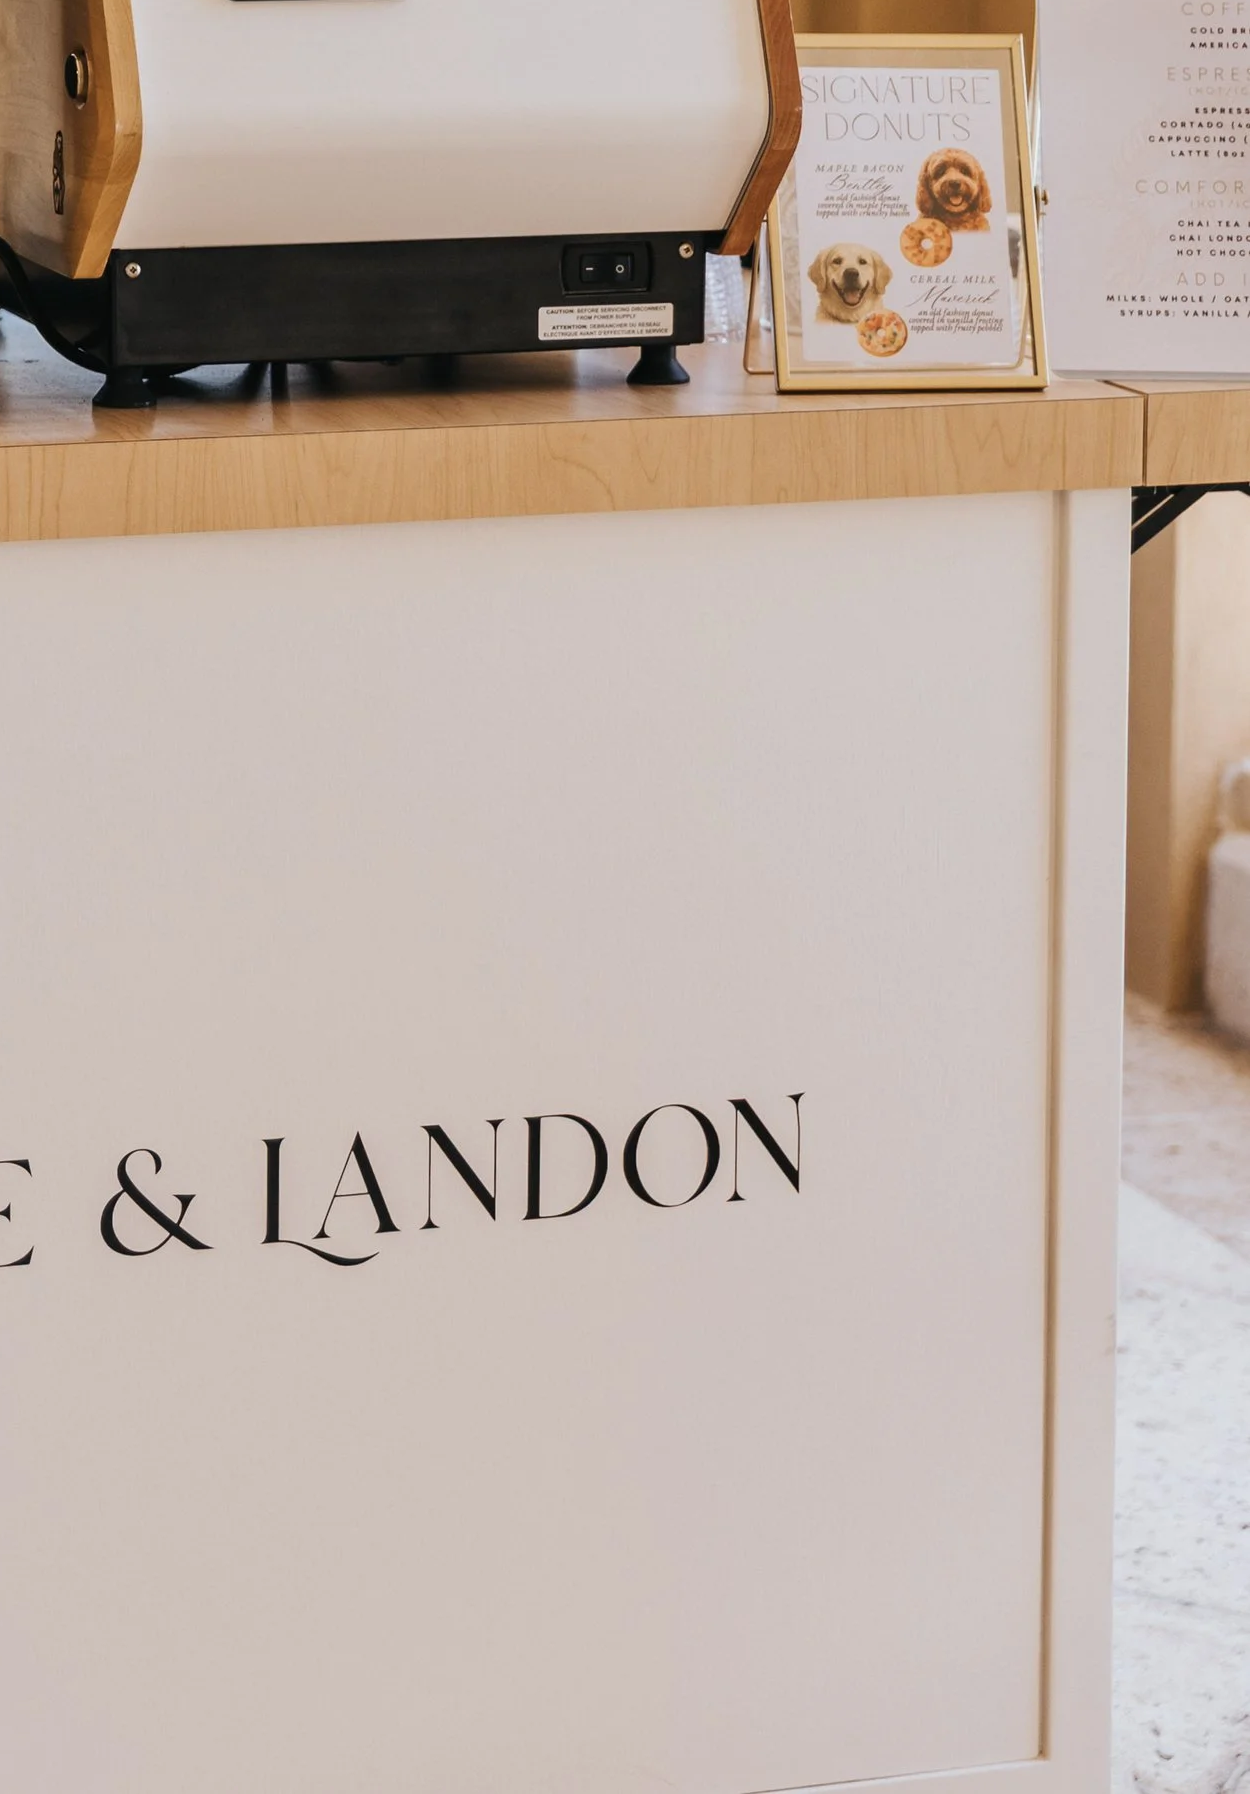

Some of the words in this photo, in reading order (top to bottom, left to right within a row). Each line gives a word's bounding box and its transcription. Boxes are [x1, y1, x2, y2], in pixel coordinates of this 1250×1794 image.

[1181, 2, 1244, 16] COFF
[1190, 27, 1224, 35] COLD
[1232, 27, 1250, 35] BR
[801, 75, 991, 104] SIGNATURE
[824, 112, 972, 142] DONUTS
[1148, 135, 1236, 143] CAPPUCCINO
[814, 164, 857, 173] MAPLE
[863, 164, 904, 173] BACON
[825, 173, 894, 195] Bentley
[1135, 180, 1244, 194] COMFOR
[1169, 234, 1201, 242] CHAI
[910, 275, 958, 284] CEREAL
[963, 275, 996, 284] MILK
[1177, 272, 1225, 286] ADD
[100, 1148, 215, 1256] &
[260, 1092, 805, 1267] LANDON
